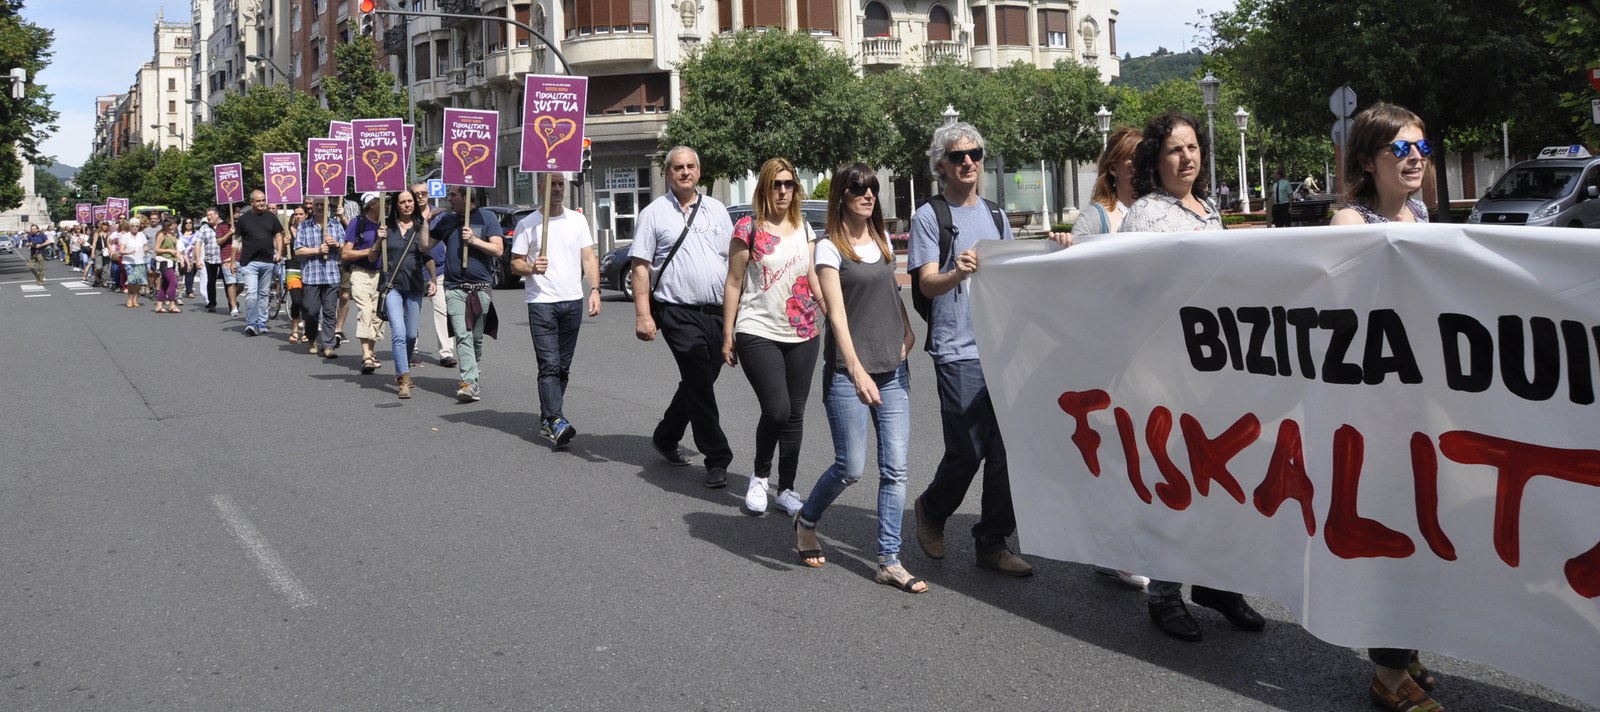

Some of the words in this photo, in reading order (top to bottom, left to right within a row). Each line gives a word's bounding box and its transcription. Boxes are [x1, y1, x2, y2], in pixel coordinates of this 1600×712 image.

[532, 99, 578, 114] JUSTUA
[450, 128, 491, 140] JUSTUA
[359, 137, 398, 149] JUSTUA
[313, 153, 343, 162] JUSTUA
[431, 182, 442, 195] P
[1179, 306, 1424, 385] BIZITZA
[1437, 312, 1600, 405] DUI
